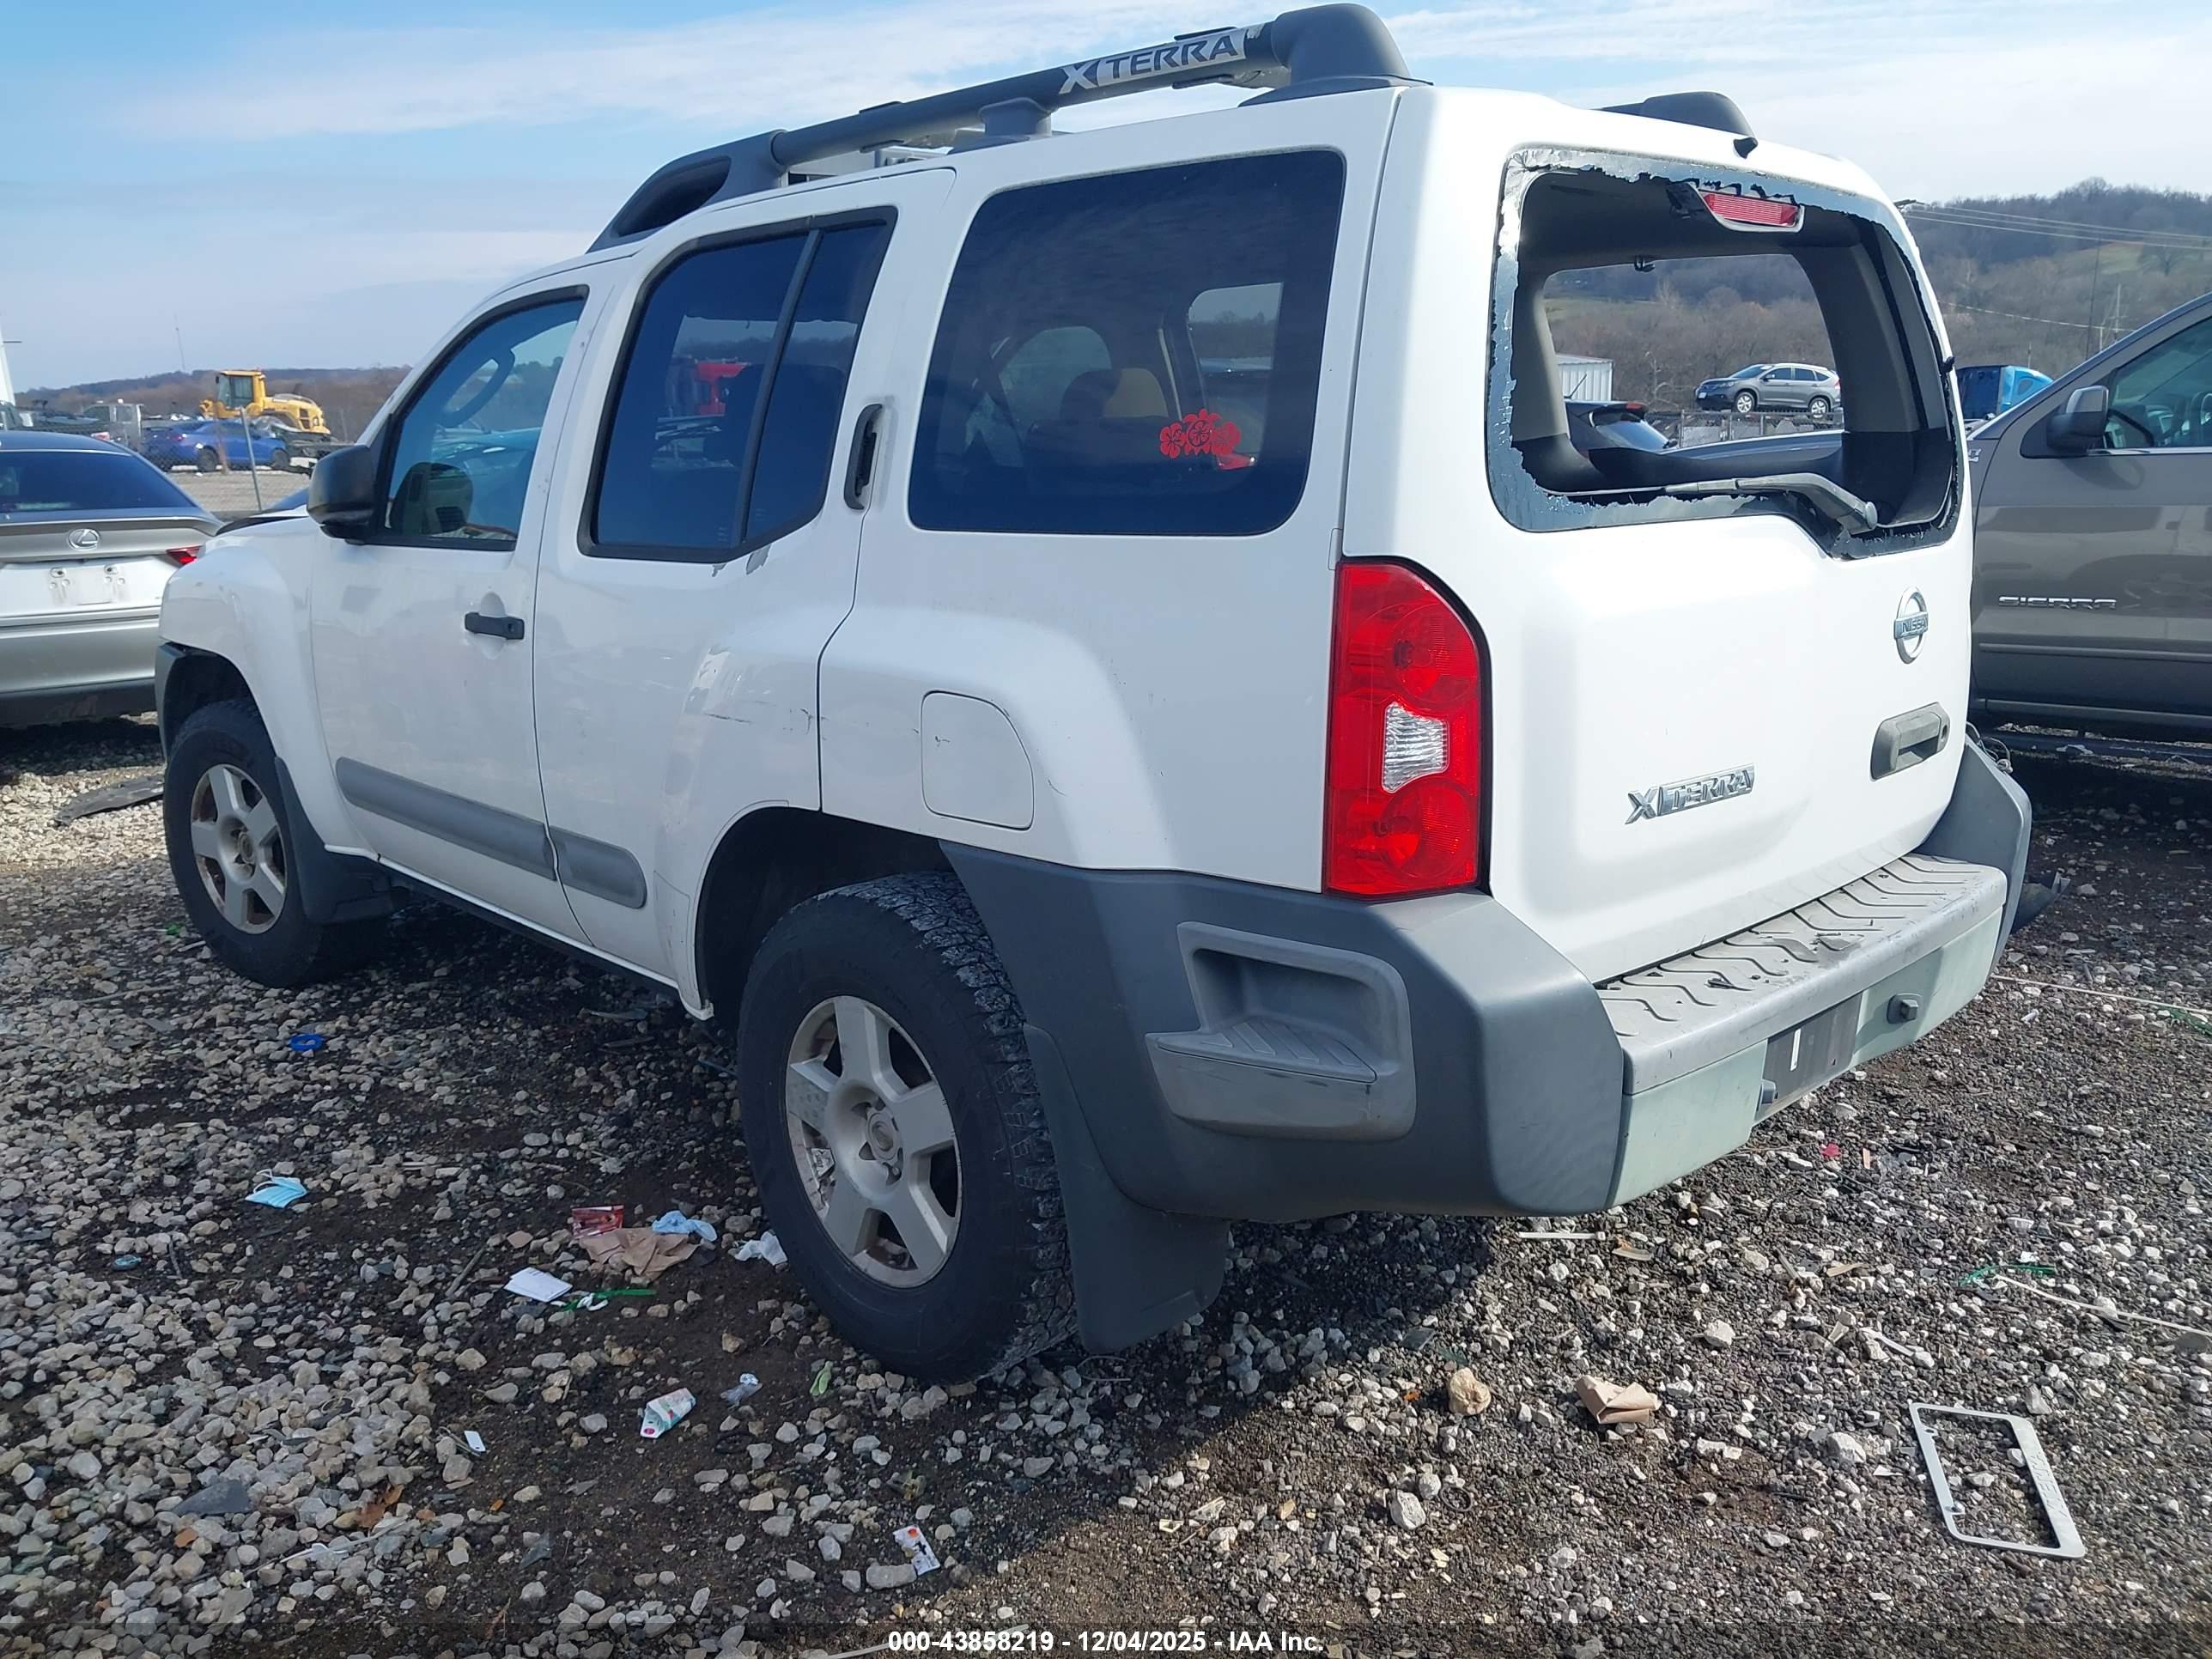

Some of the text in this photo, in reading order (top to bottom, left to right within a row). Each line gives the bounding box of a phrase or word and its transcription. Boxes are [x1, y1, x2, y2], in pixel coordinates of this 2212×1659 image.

[1059, 34, 1239, 94] XTERRA
[1998, 596, 2117, 610] SIERRA
[1902, 617, 1928, 633] NISSA
[1625, 766, 1753, 824] XTERRA
